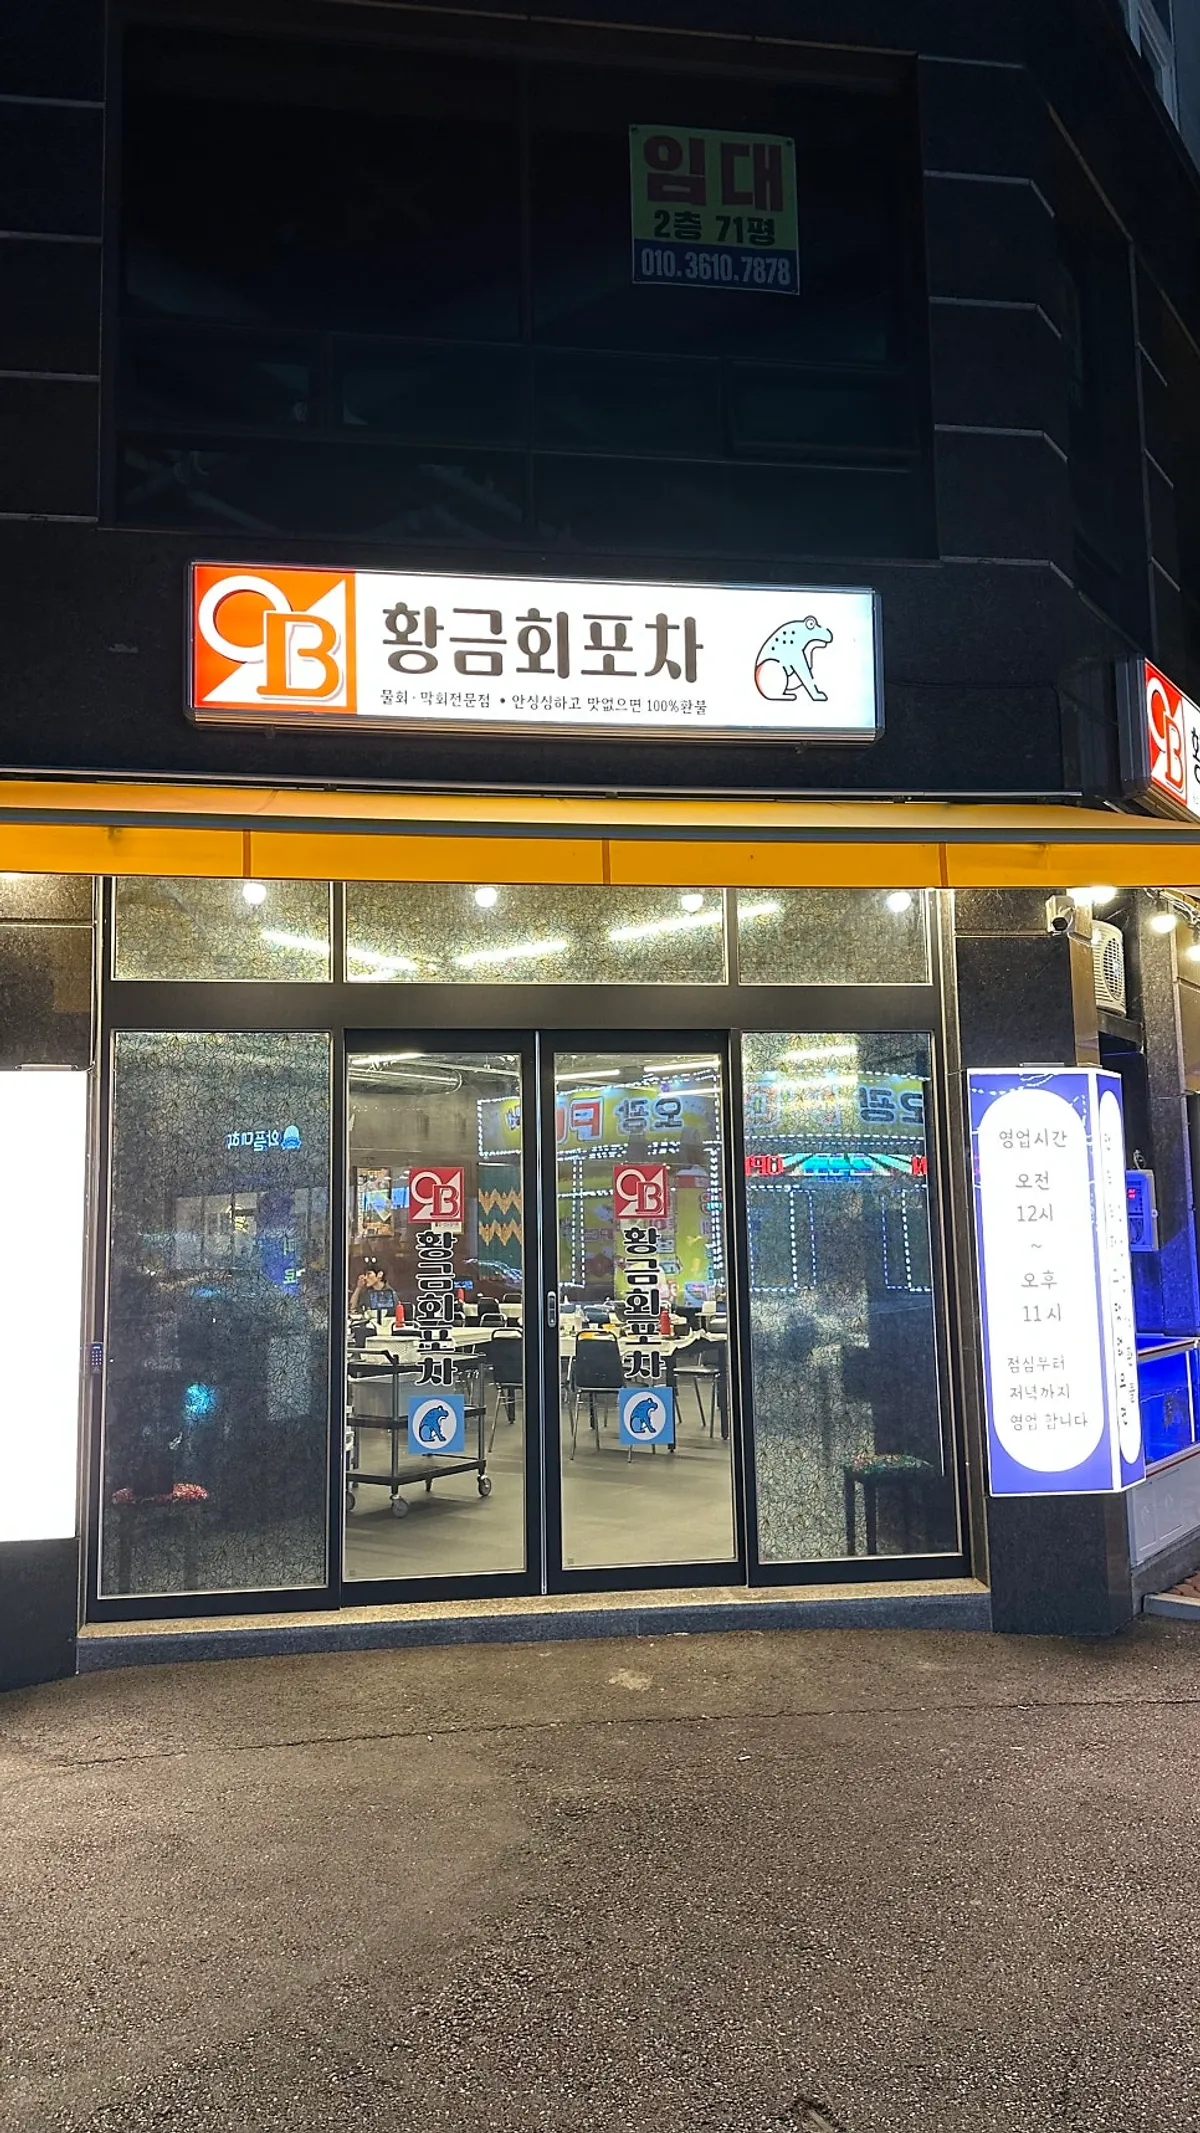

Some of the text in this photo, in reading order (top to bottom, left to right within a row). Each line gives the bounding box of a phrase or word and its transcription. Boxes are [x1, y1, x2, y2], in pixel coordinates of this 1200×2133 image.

[643, 135, 784, 212] 임대
[654, 210, 776, 247] 2층 71평
[641, 248, 790, 285] 010.3610.7878
[382, 601, 704, 683] 황금회포차
[511, 693, 582, 711] 안싱싱하고
[587, 696, 642, 713] 맛없으면
[998, 1127, 1069, 1149] 영업시간
[1015, 1170, 1051, 1191] 오전
[1016, 1203, 1054, 1223] 12시
[1021, 1269, 1058, 1290] 오후
[415, 1231, 459, 1387] 황금회포차
[622, 1226, 666, 1380] 황금회포차
[1007, 1355, 1066, 1374] 점심부터
[1009, 1383, 1071, 1401] 저녁까지
[1009, 1410, 1089, 1432] 영업 합니다
